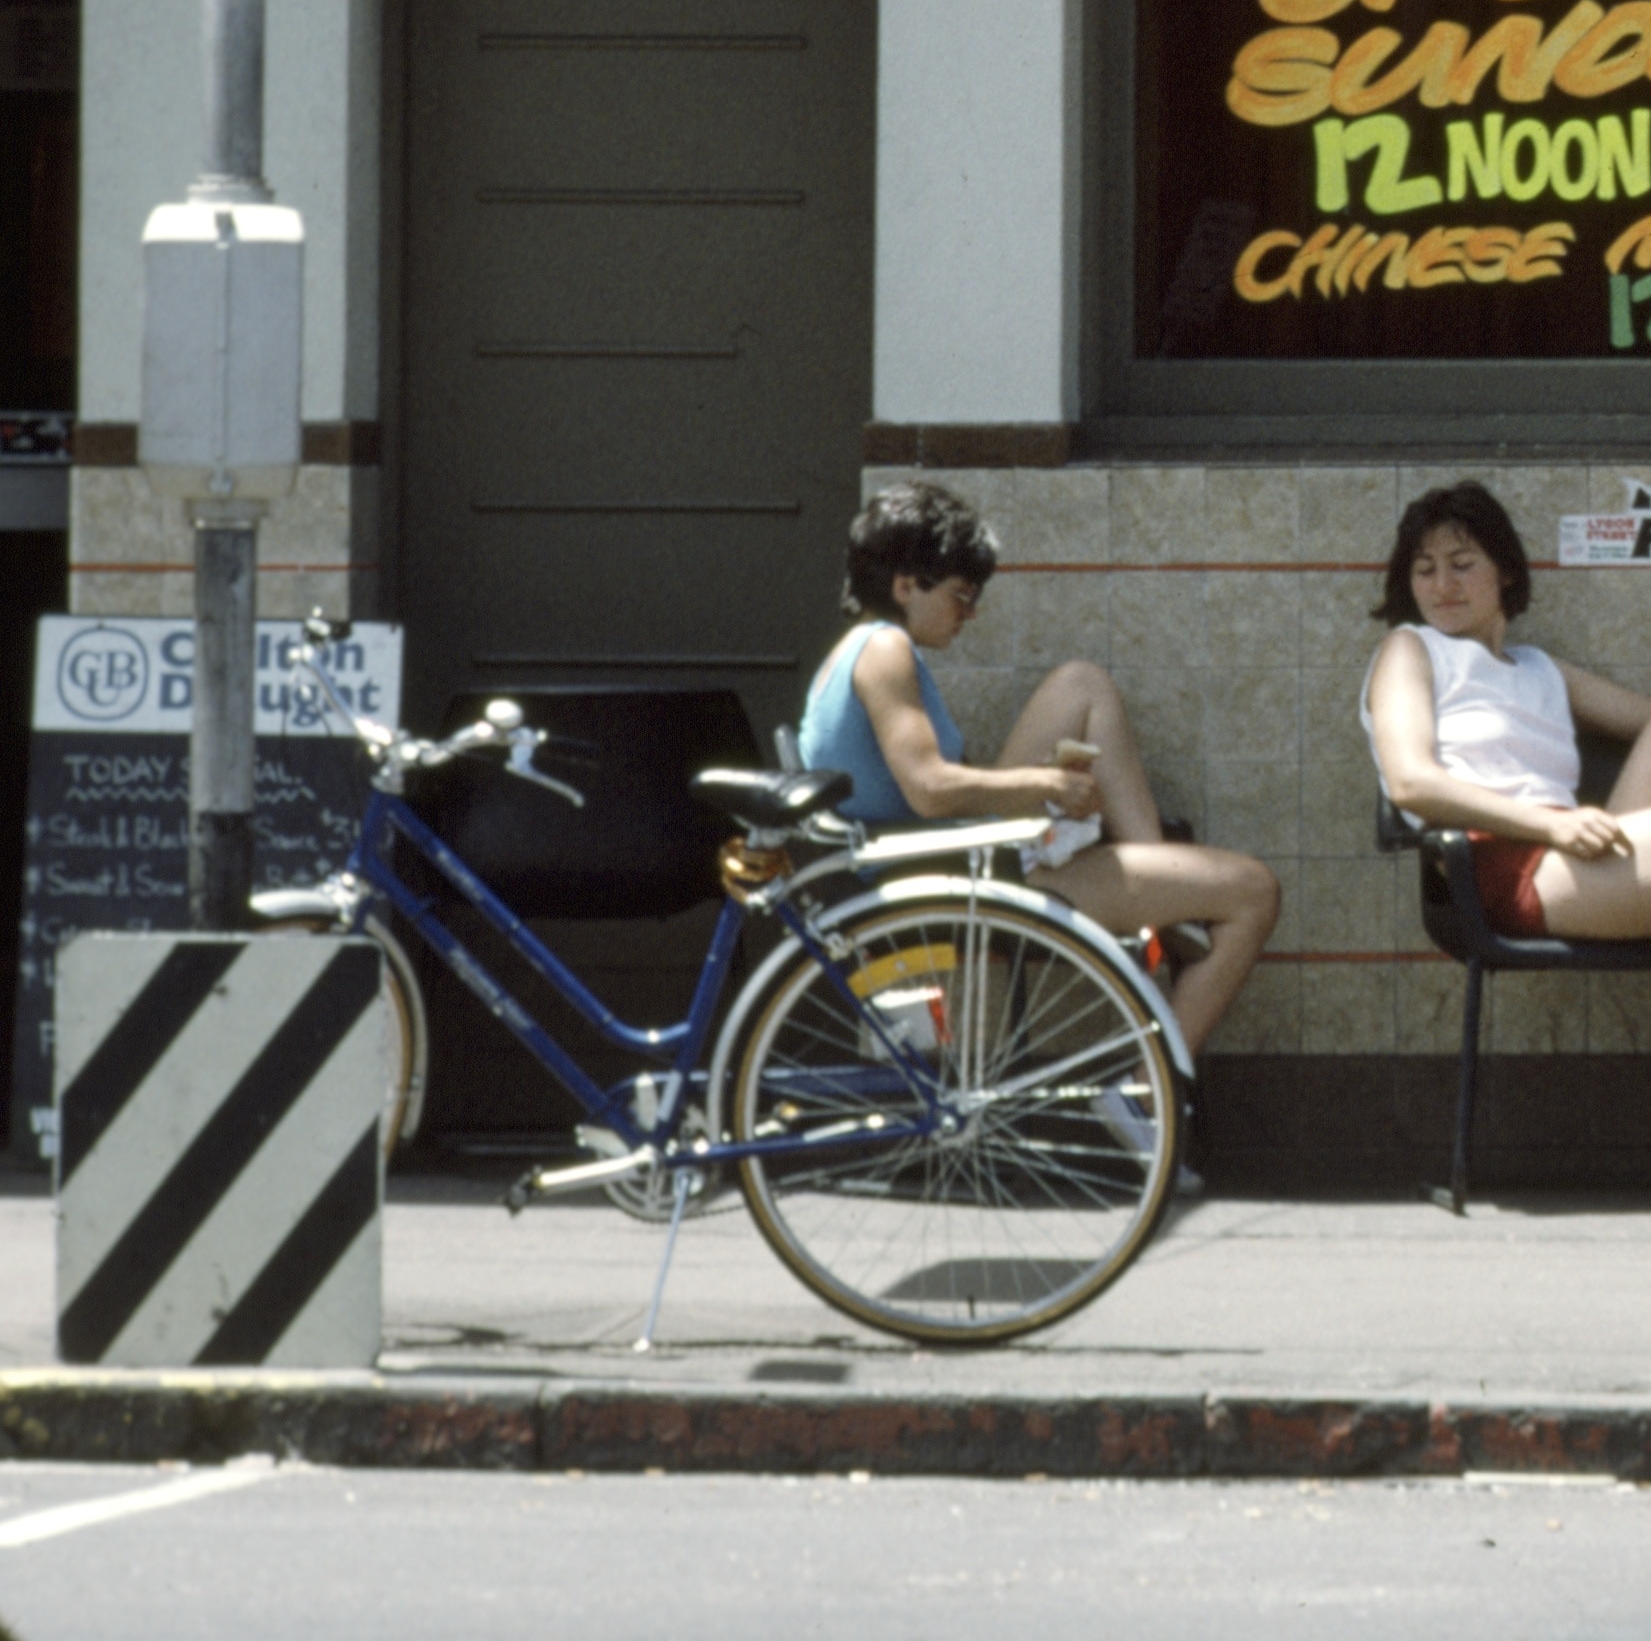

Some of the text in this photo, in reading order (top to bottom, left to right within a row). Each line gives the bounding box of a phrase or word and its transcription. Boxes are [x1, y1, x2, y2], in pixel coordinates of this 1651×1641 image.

[1313, 114, 1443, 215] 12
[1234, 221, 1576, 303] CHINESE
[63, 753, 172, 785] TODAY
